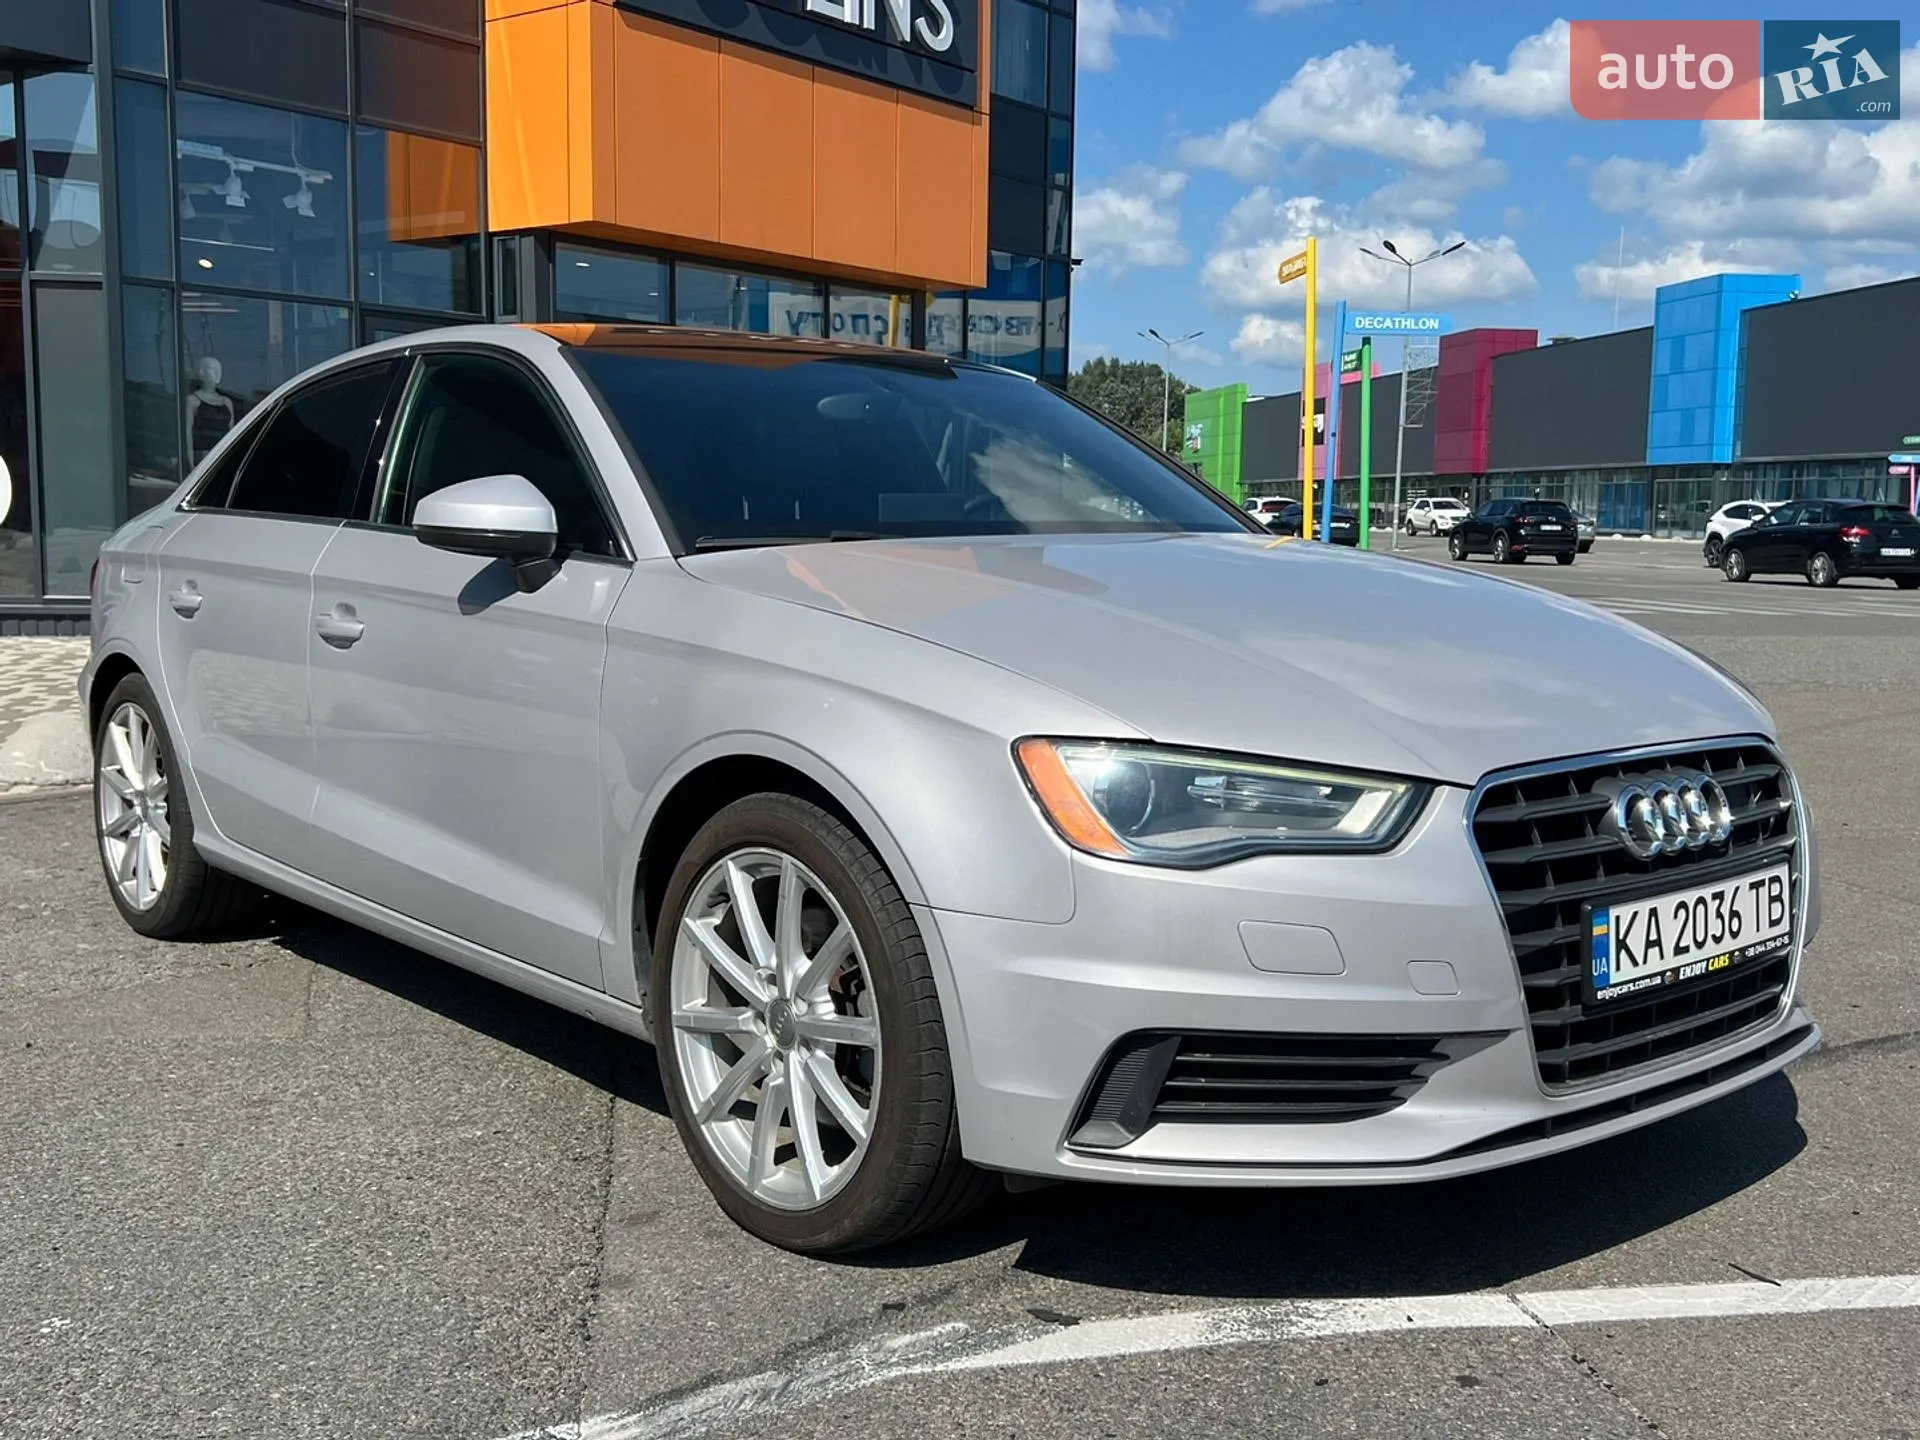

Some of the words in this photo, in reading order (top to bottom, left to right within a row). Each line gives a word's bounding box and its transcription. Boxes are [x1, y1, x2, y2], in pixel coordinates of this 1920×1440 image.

[1355, 316, 1439, 330] DECATHLON
[1614, 907, 1664, 972] KA
[1672, 886, 1742, 959] 2036
[1748, 875, 1785, 933] TB
[1592, 958, 1608, 977] UA
[1597, 975, 1661, 1000] enjoycars.com.ua
[1679, 961, 1708, 980] ENJOY
[1708, 954, 1730, 971] CARS
